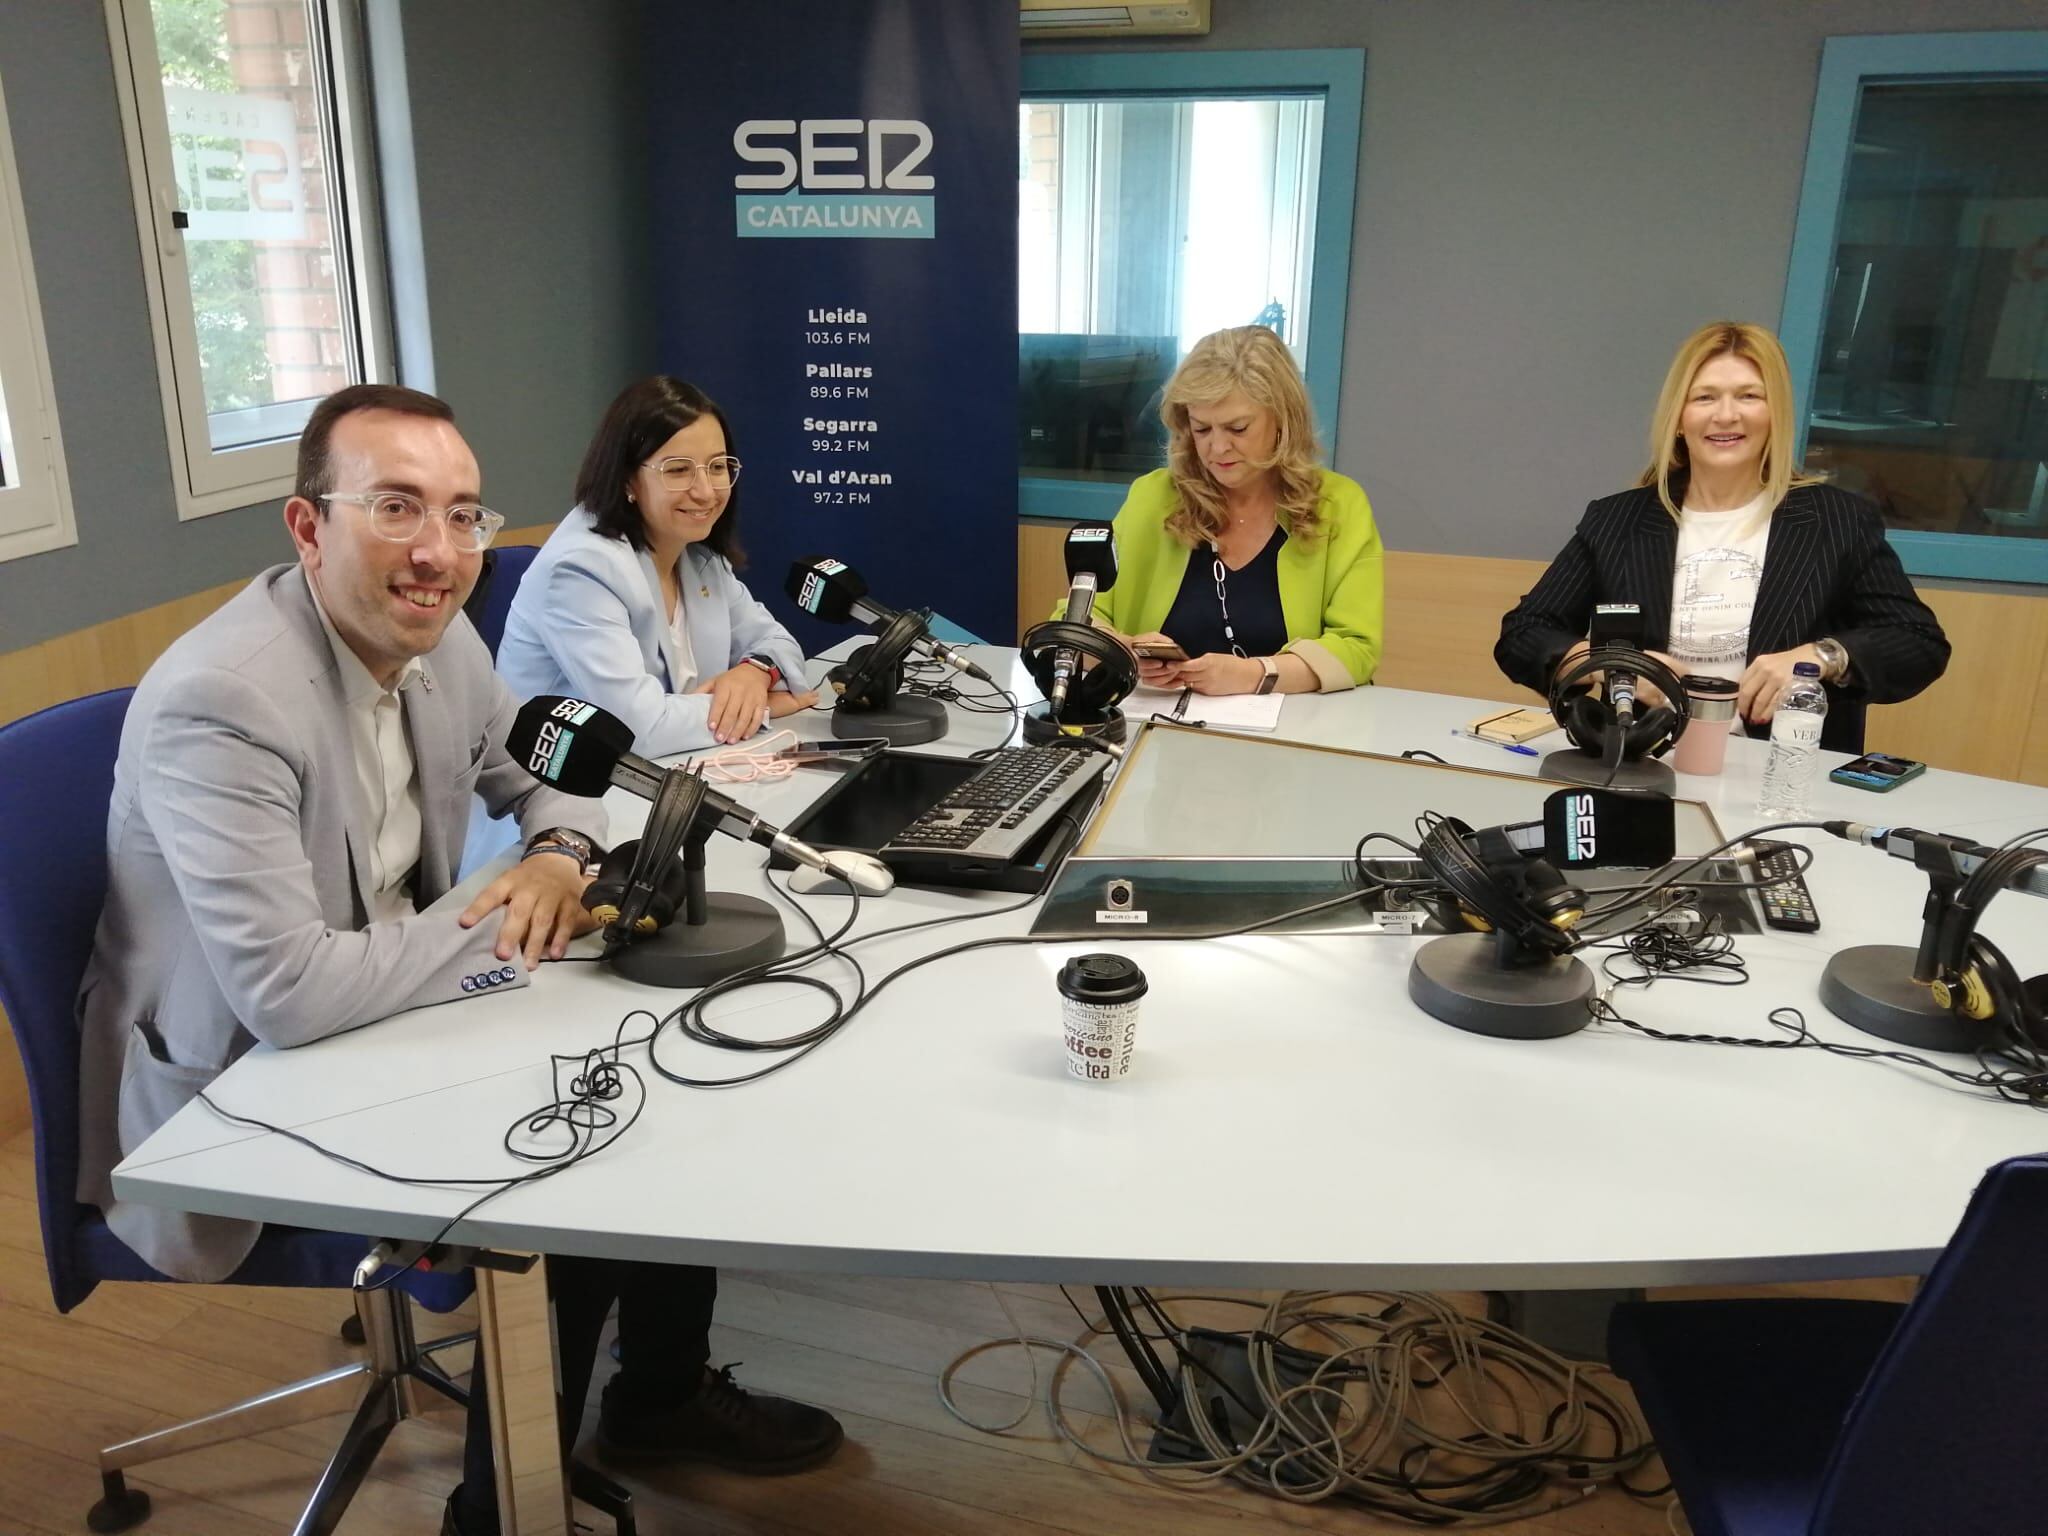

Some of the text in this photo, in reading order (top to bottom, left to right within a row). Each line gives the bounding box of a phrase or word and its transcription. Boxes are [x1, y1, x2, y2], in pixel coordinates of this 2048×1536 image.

[733, 119, 936, 190] SER
[747, 205, 923, 229] CATALUNYA
[807, 308, 868, 325] Lleida
[805, 331, 871, 345] 103.6 FM
[805, 363, 873, 379] Pallars
[810, 386, 869, 399] 89.6 FM
[803, 417, 878, 436] Segarra
[811, 439, 870, 453] 99.2 FM
[792, 470, 892, 485] Val d'Aran
[813, 492, 871, 505] 97.2 FM
[1071, 528, 1110, 537] SER
[798, 571, 819, 611] SER
[550, 698, 586, 721] SER
[529, 721, 563, 775] SER
[1575, 794, 1596, 860] SER
[1119, 1022, 1136, 1075] coffee
[1085, 1060, 1111, 1079] tea
